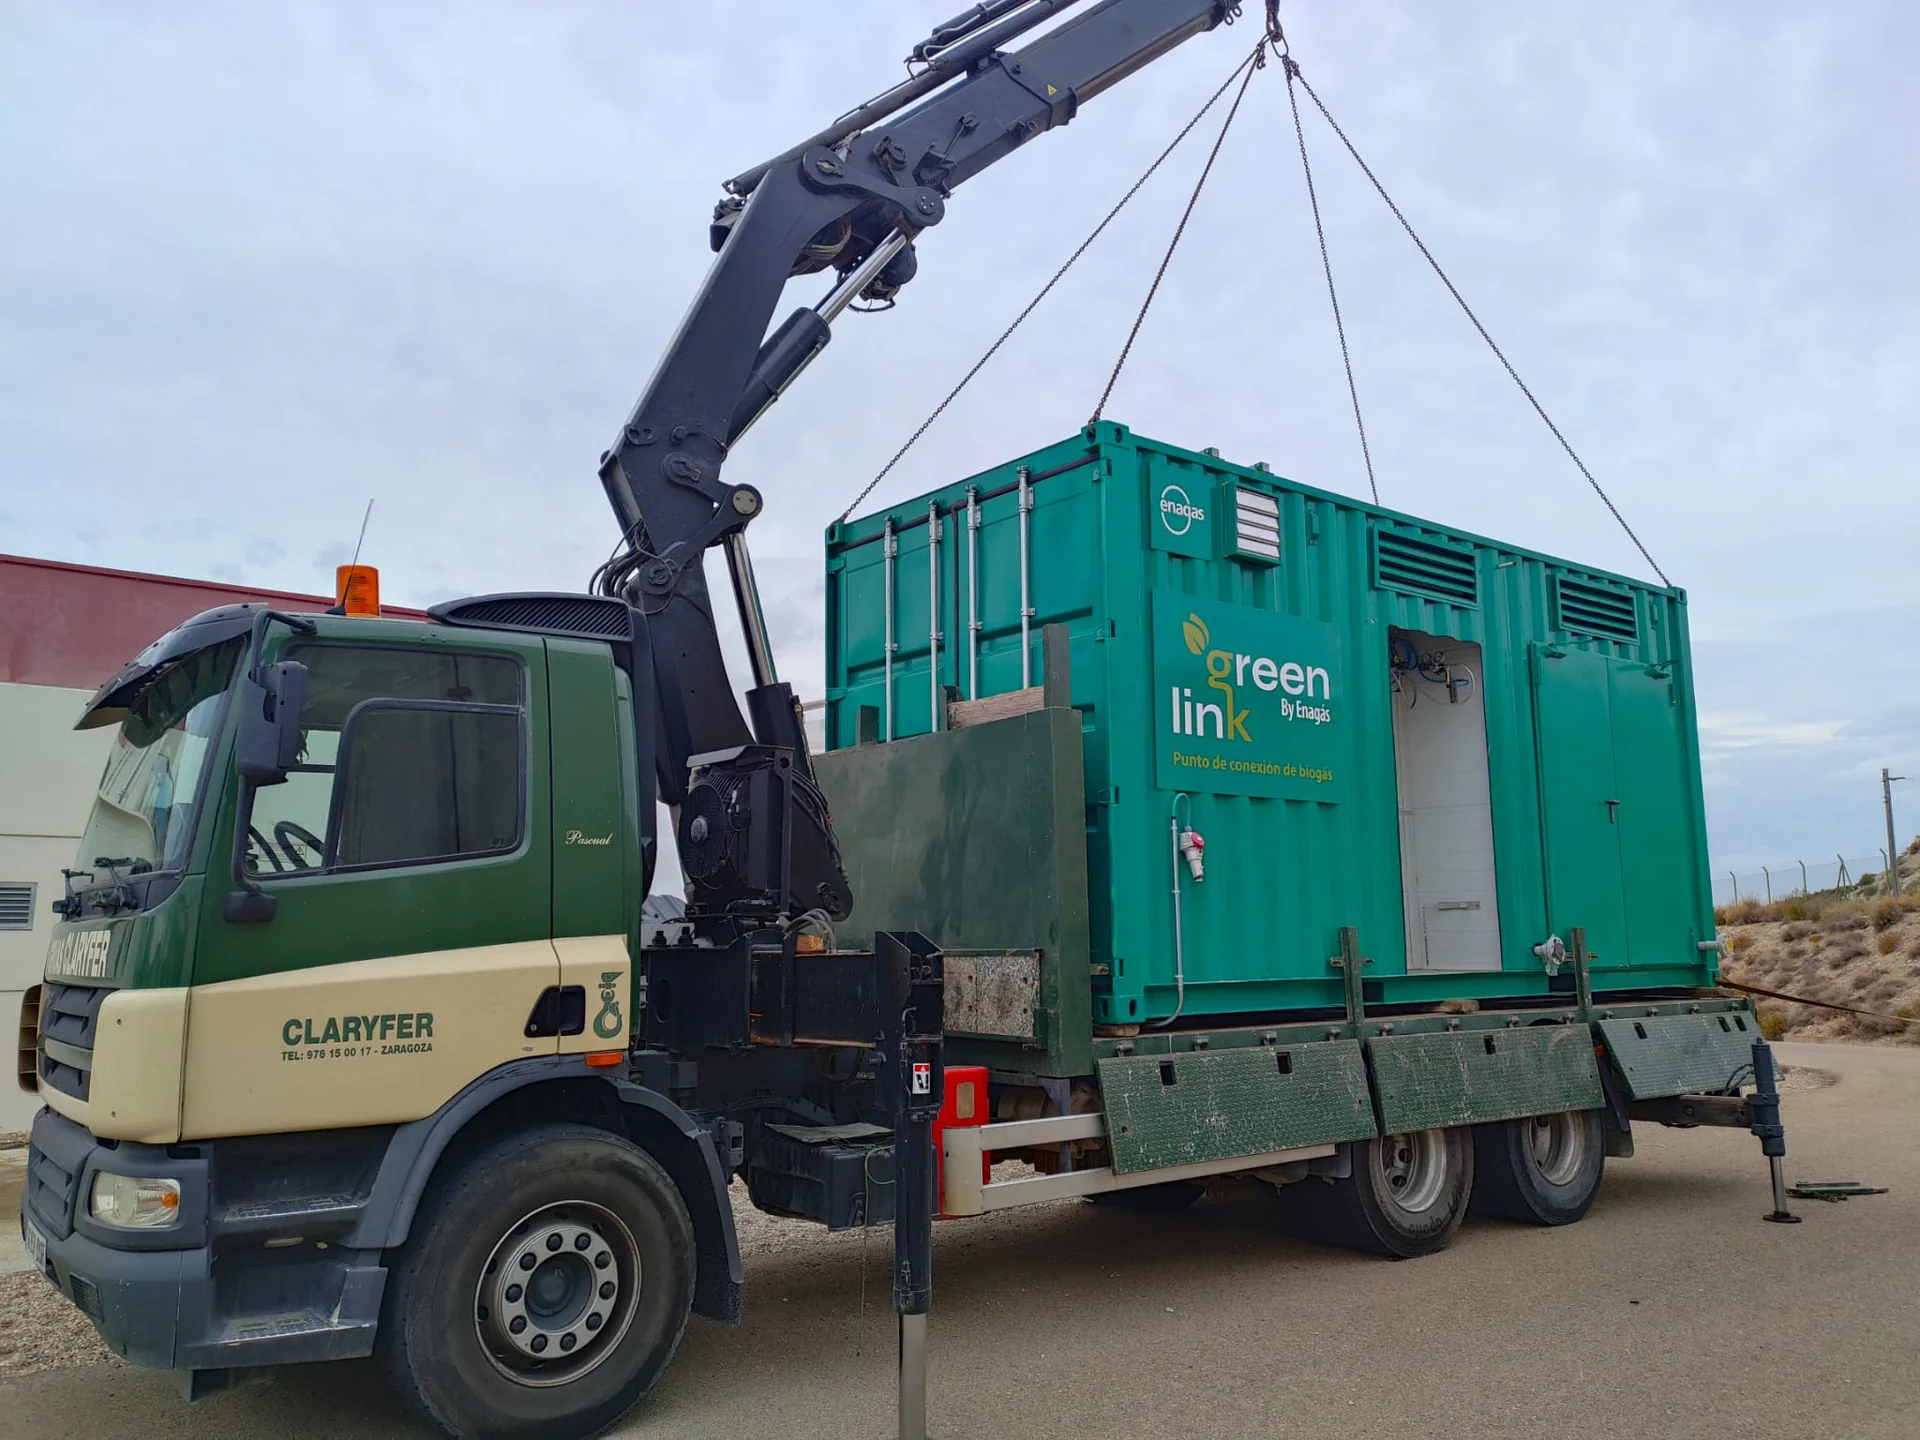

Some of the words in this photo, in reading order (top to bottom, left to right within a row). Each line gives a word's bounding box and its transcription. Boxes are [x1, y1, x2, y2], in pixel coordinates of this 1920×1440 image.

[1206, 649, 1331, 700] green
[1172, 684, 1253, 742] link
[1281, 698, 1294, 721] By
[1296, 700, 1331, 725] Enagás
[1173, 751, 1210, 769] Punto
[1212, 755, 1227, 770] de
[1229, 759, 1281, 776] conexión
[1283, 762, 1297, 777] de
[1299, 764, 1333, 784] biogás
[564, 830, 613, 845] Pascual
[62, 930, 110, 977] CLARYFER
[282, 1013, 433, 1046] CLARYFER
[281, 1051, 304, 1061] TEL:
[306, 1050, 326, 1060] 976
[329, 1048, 341, 1058] 15
[344, 1047, 357, 1057] 00
[360, 1046, 372, 1056] 17
[381, 1042, 433, 1055] ZARAGOZA
